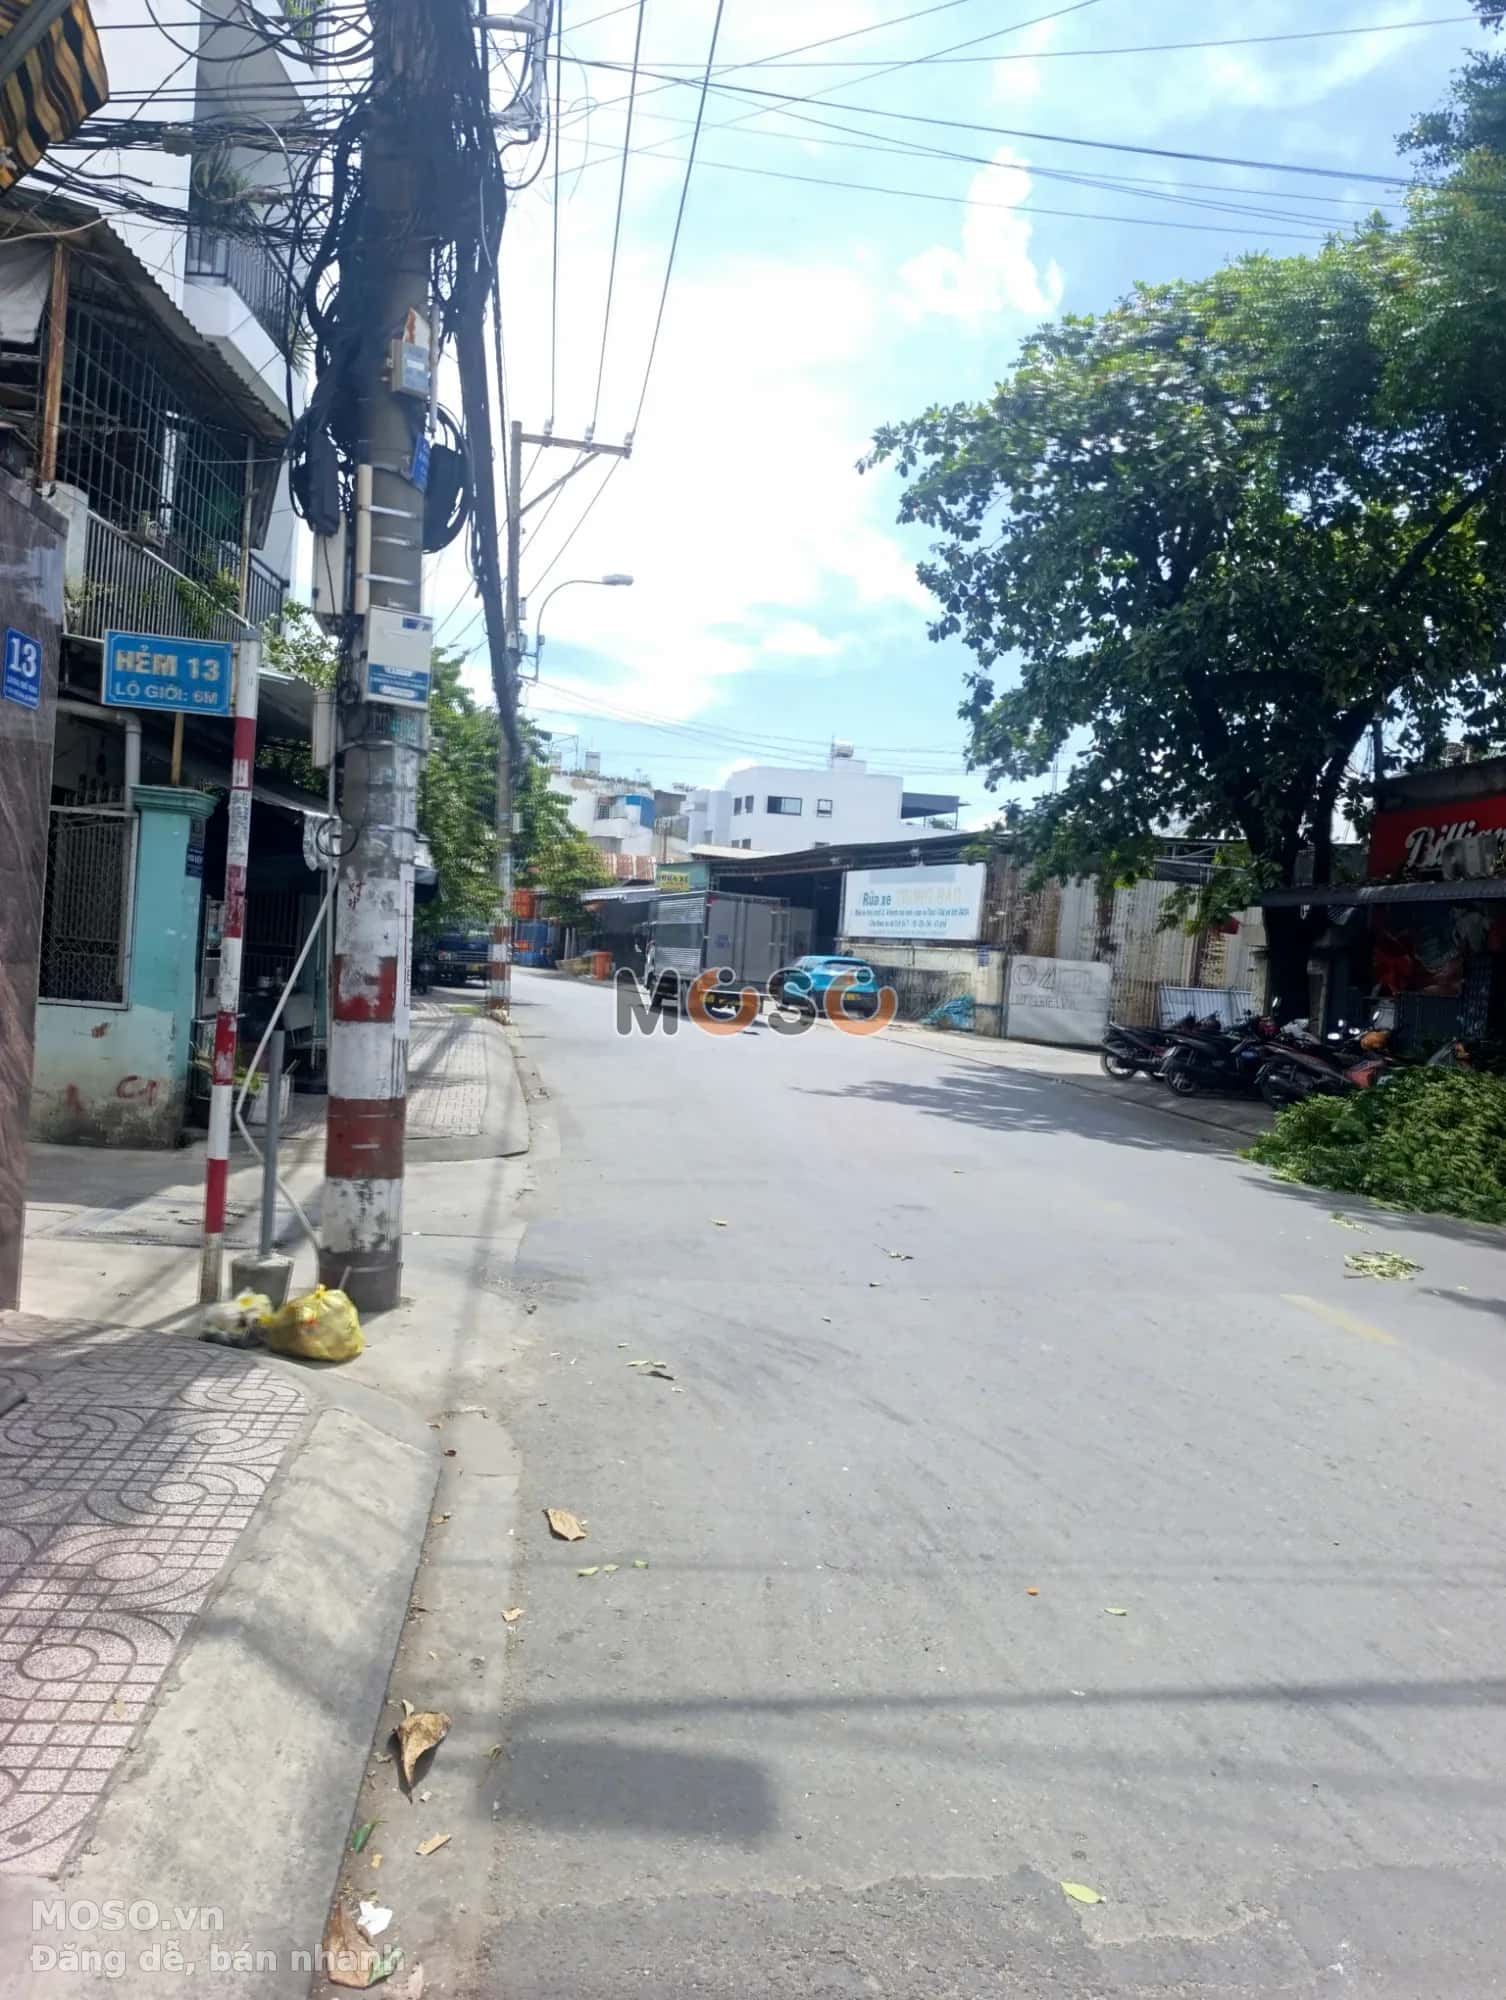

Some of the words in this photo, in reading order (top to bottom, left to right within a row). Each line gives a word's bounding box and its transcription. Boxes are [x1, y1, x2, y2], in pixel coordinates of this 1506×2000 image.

[9, 637, 37, 678] 13
[115, 644, 178, 677] HẺM
[188, 656, 220, 681] 13
[193, 690, 218, 704] 6M
